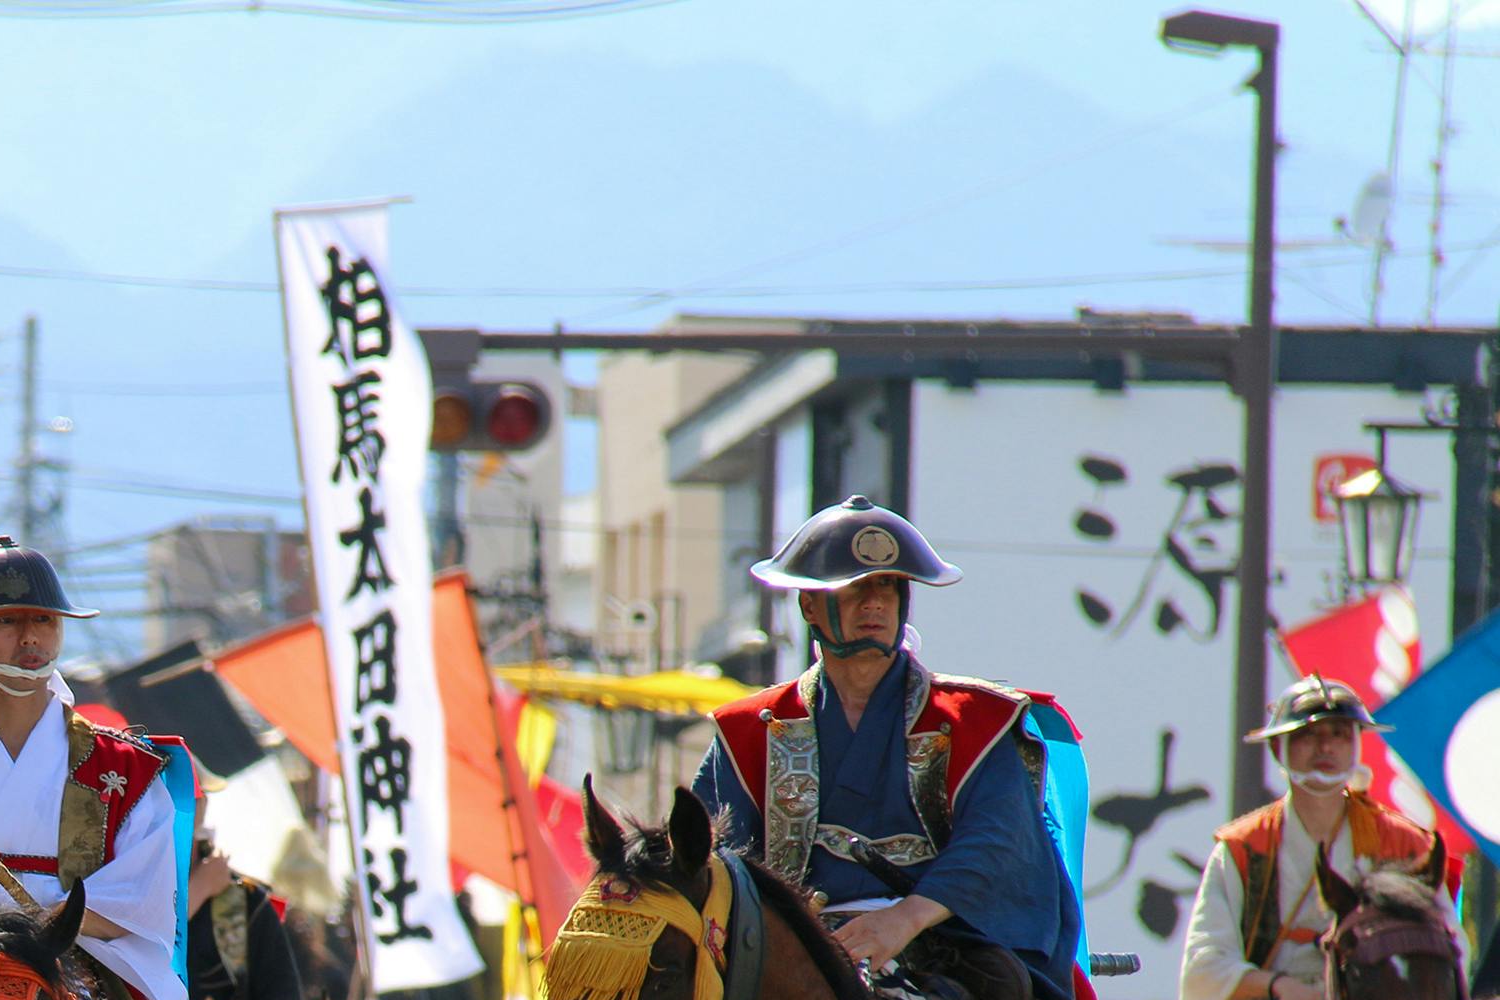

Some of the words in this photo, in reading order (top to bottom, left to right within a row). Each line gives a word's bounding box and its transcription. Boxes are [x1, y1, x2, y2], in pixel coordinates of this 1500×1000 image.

[318, 246, 432, 946] 相馬太田神社
